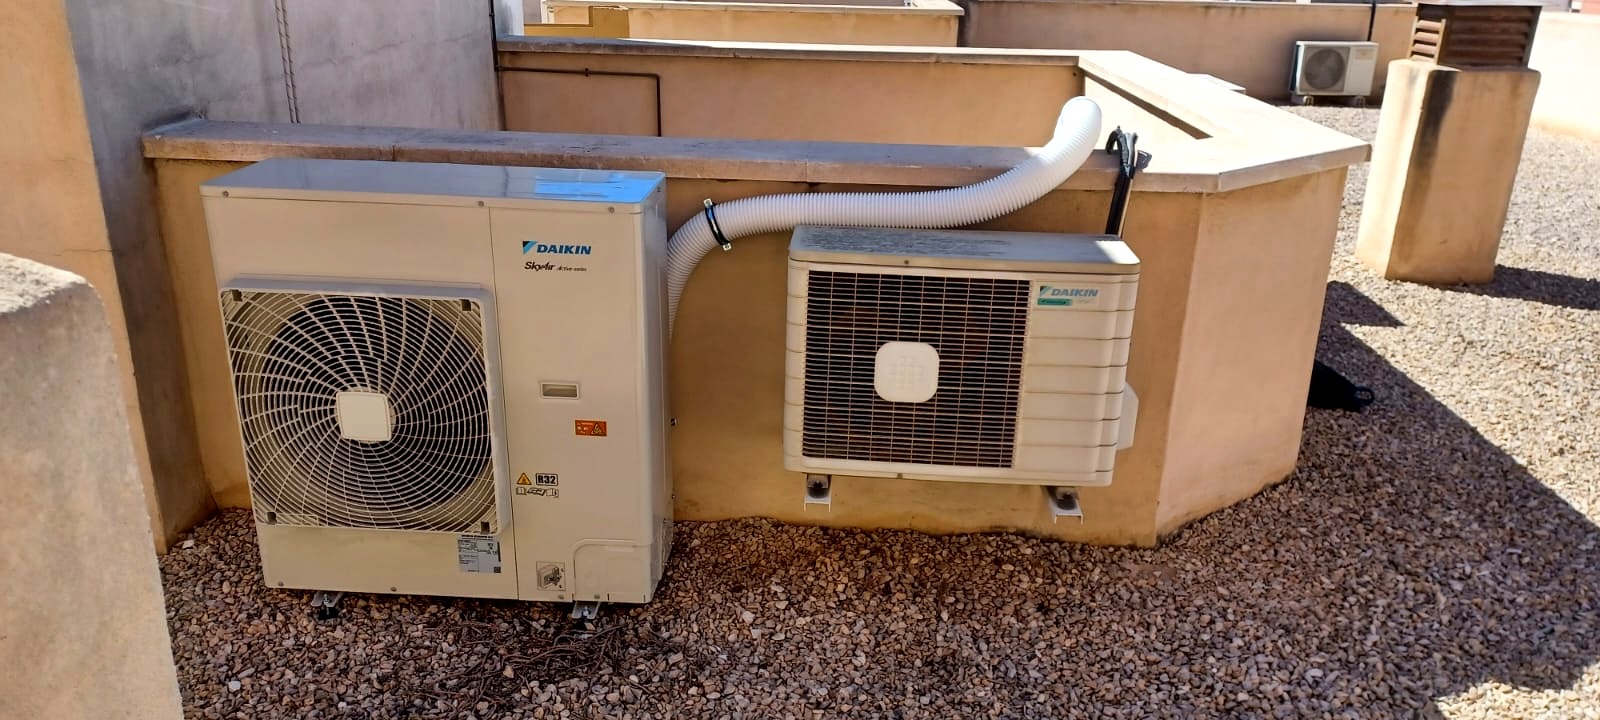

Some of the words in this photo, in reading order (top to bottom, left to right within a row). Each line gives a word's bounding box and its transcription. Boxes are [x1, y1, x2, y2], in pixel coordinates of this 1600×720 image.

[537, 244, 592, 255] DAIKIN
[1051, 288, 1098, 297] DAIKIN
[537, 475, 556, 484] R32
